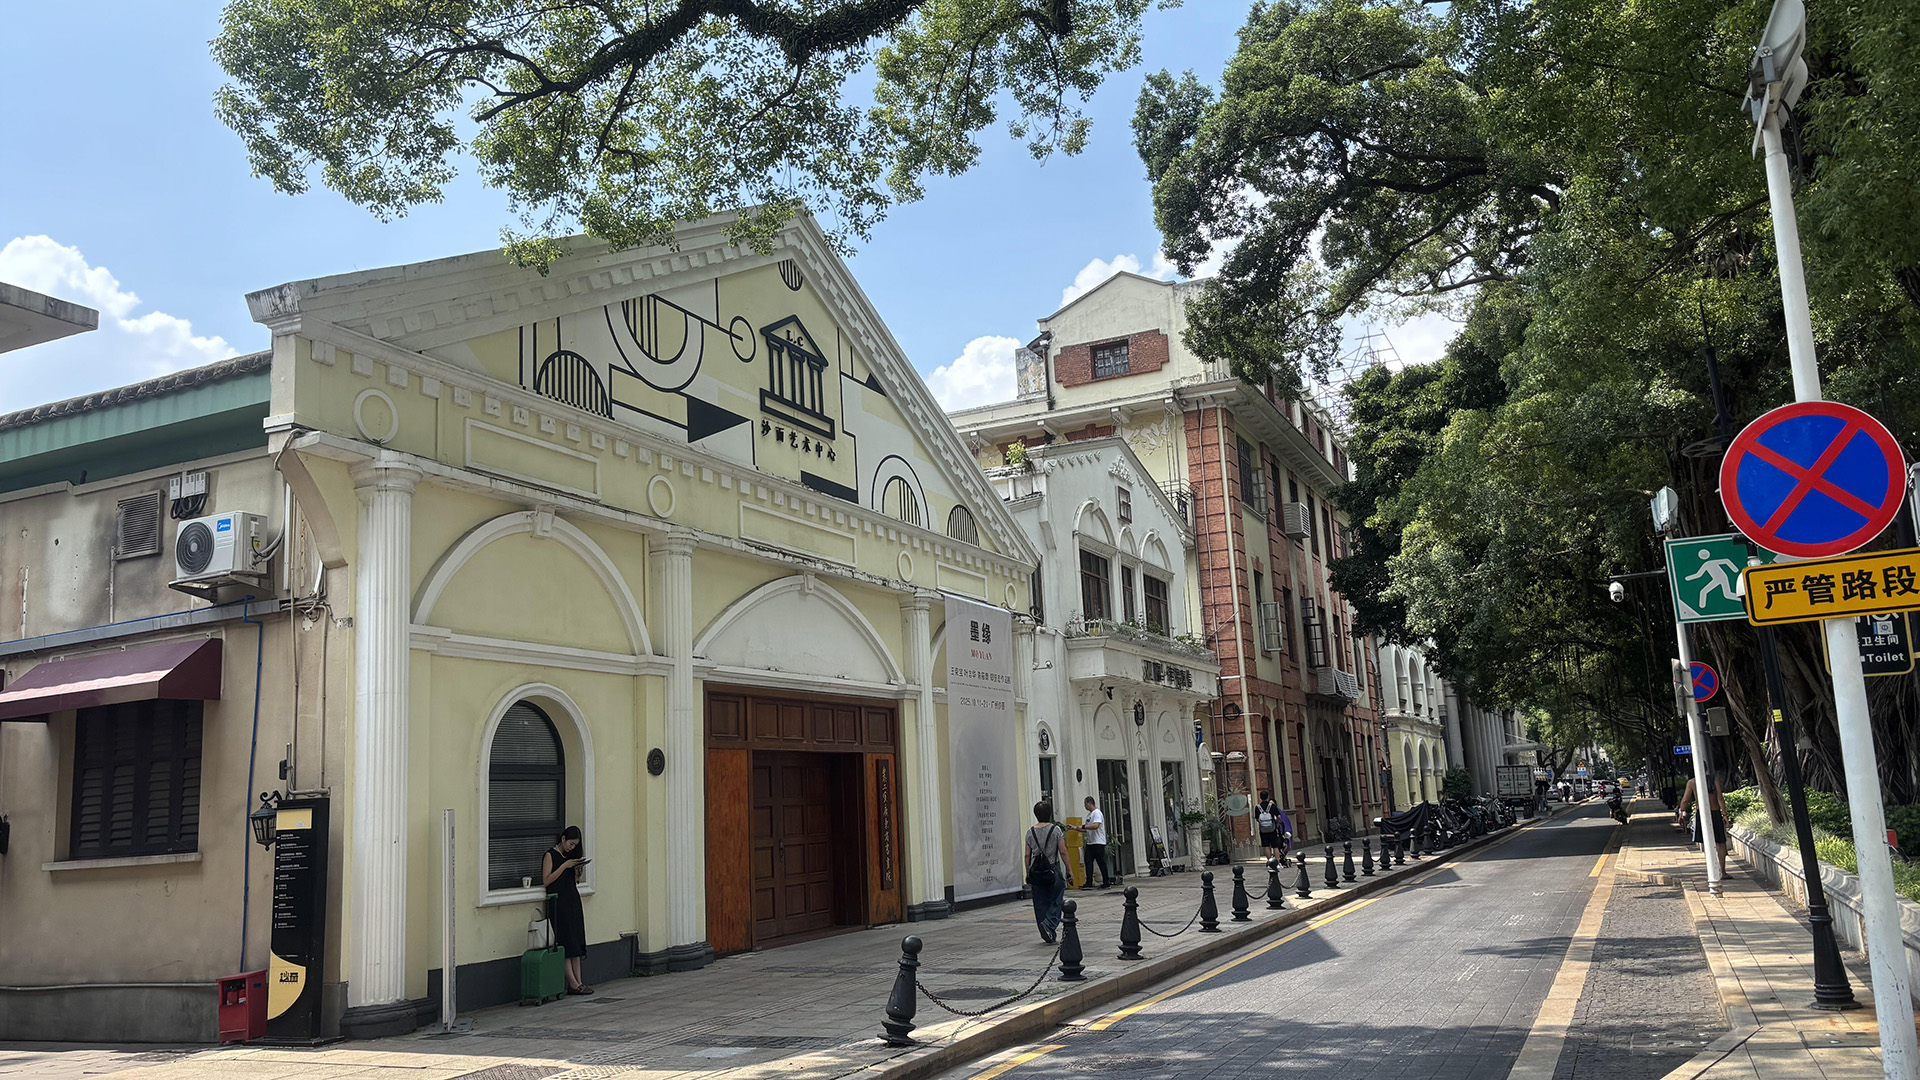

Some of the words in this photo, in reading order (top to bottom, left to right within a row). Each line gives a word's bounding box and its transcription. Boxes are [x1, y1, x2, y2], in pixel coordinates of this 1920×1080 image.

[761, 419, 836, 462] 沙面艺术中心
[1763, 565, 1920, 610] 严管路段
[970, 620, 992, 645] 墨缘
[1857, 635, 1899, 647] 卫生间
[1866, 652, 1905, 664] Toilet
